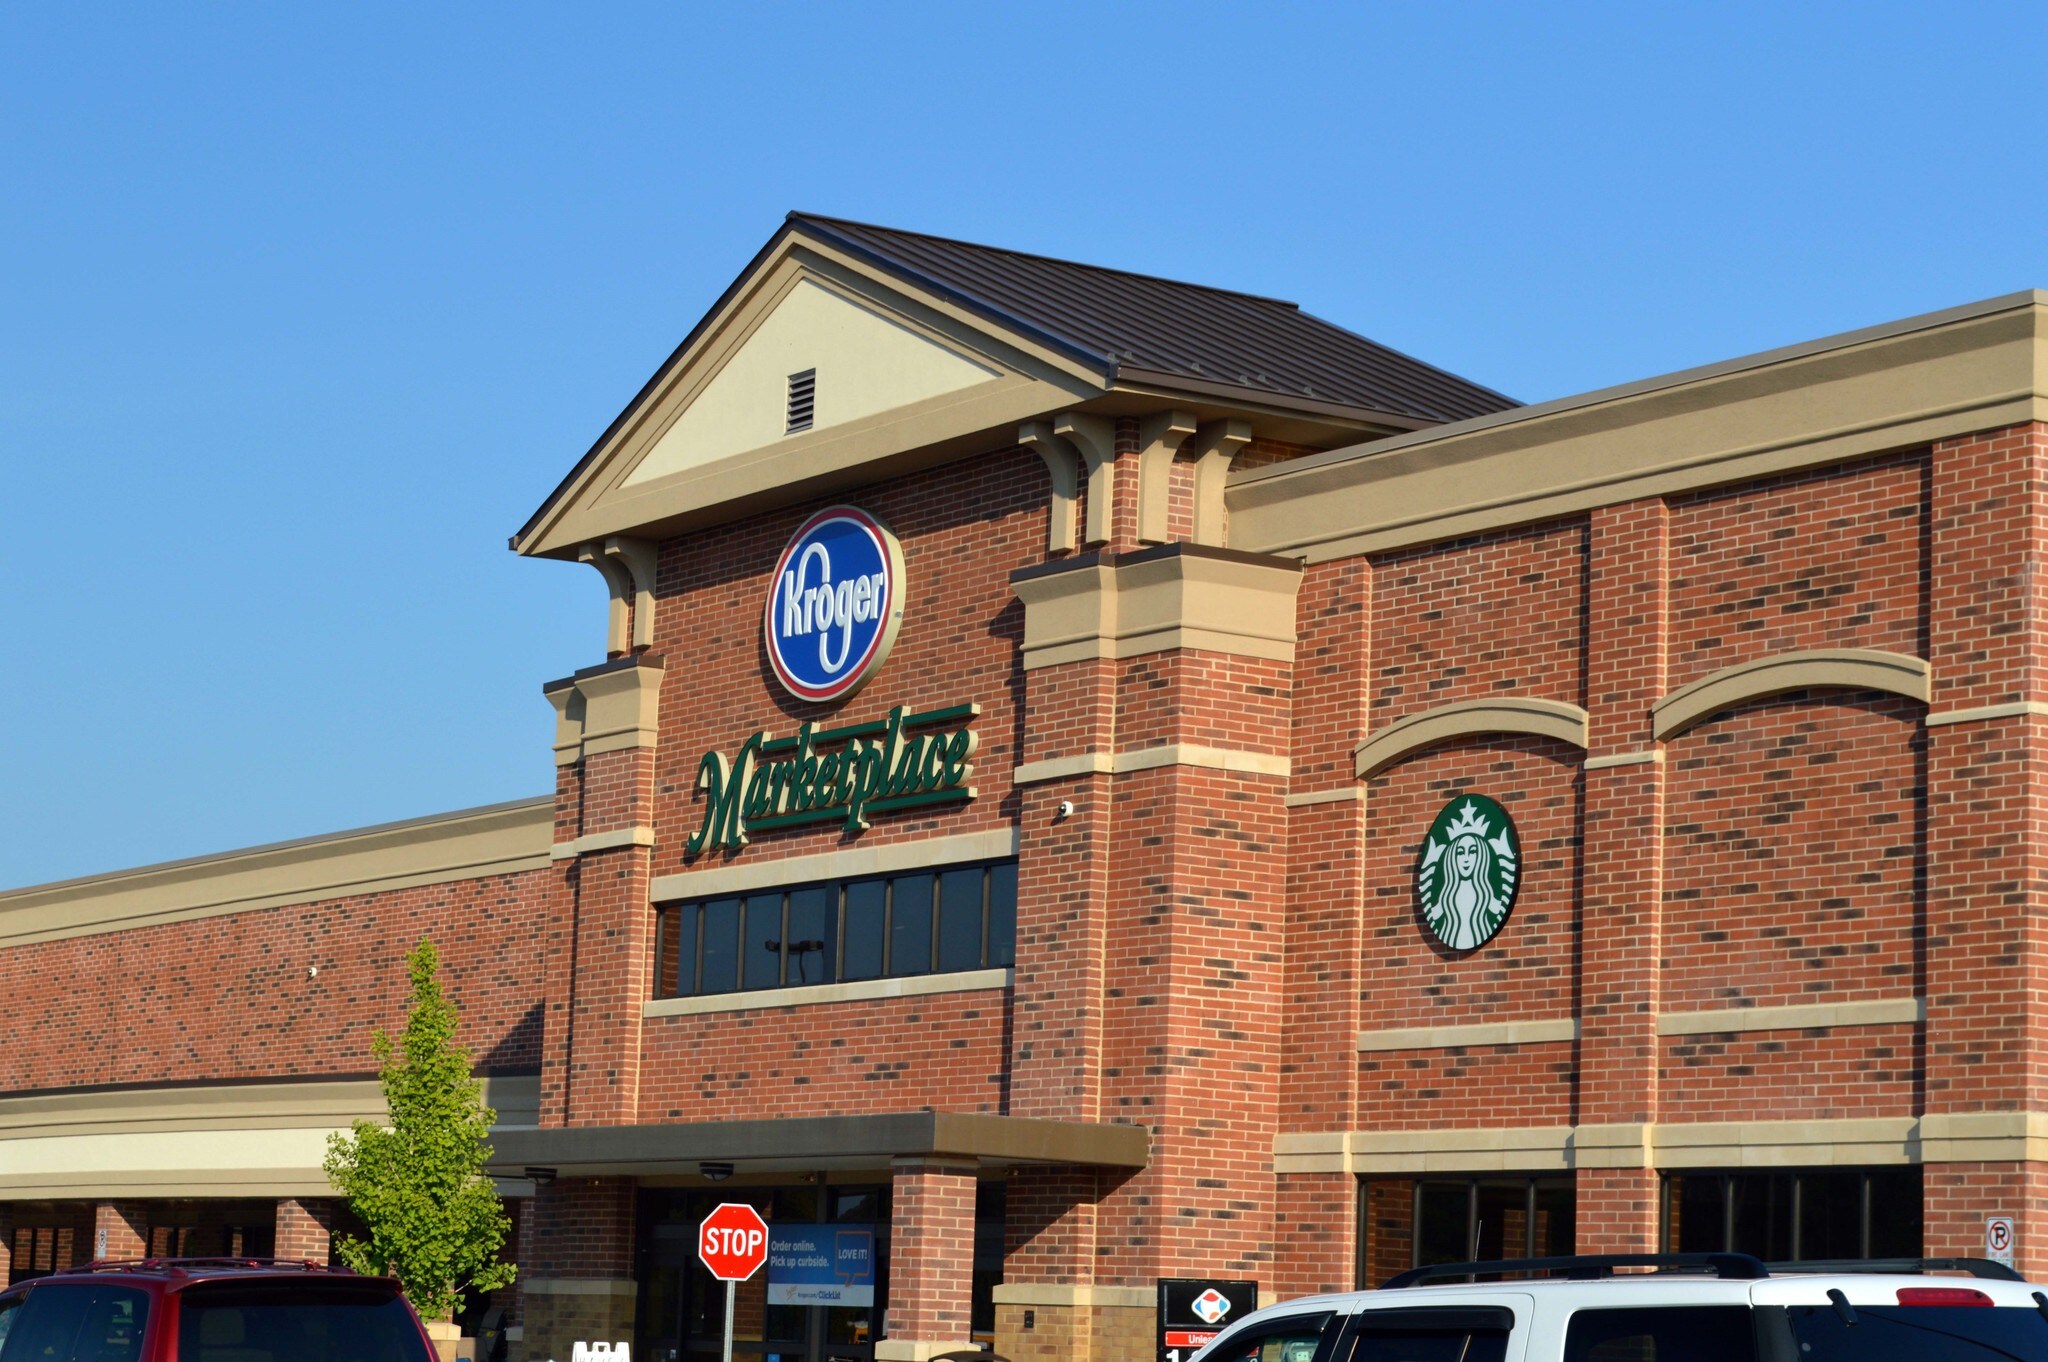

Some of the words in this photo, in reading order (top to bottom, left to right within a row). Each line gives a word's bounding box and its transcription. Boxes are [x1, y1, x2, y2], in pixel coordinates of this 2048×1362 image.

[783, 542, 884, 674] Kroger
[688, 704, 977, 854] Marketplace
[705, 1228, 762, 1257] STOP
[771, 1240, 791, 1251] Order
[792, 1240, 816, 1251] online.
[770, 1256, 785, 1267] Pick
[786, 1258, 796, 1268] up
[797, 1256, 829, 1267] curbside.
[838, 1249, 857, 1260] LOVE
[858, 1249, 868, 1260] IT!
